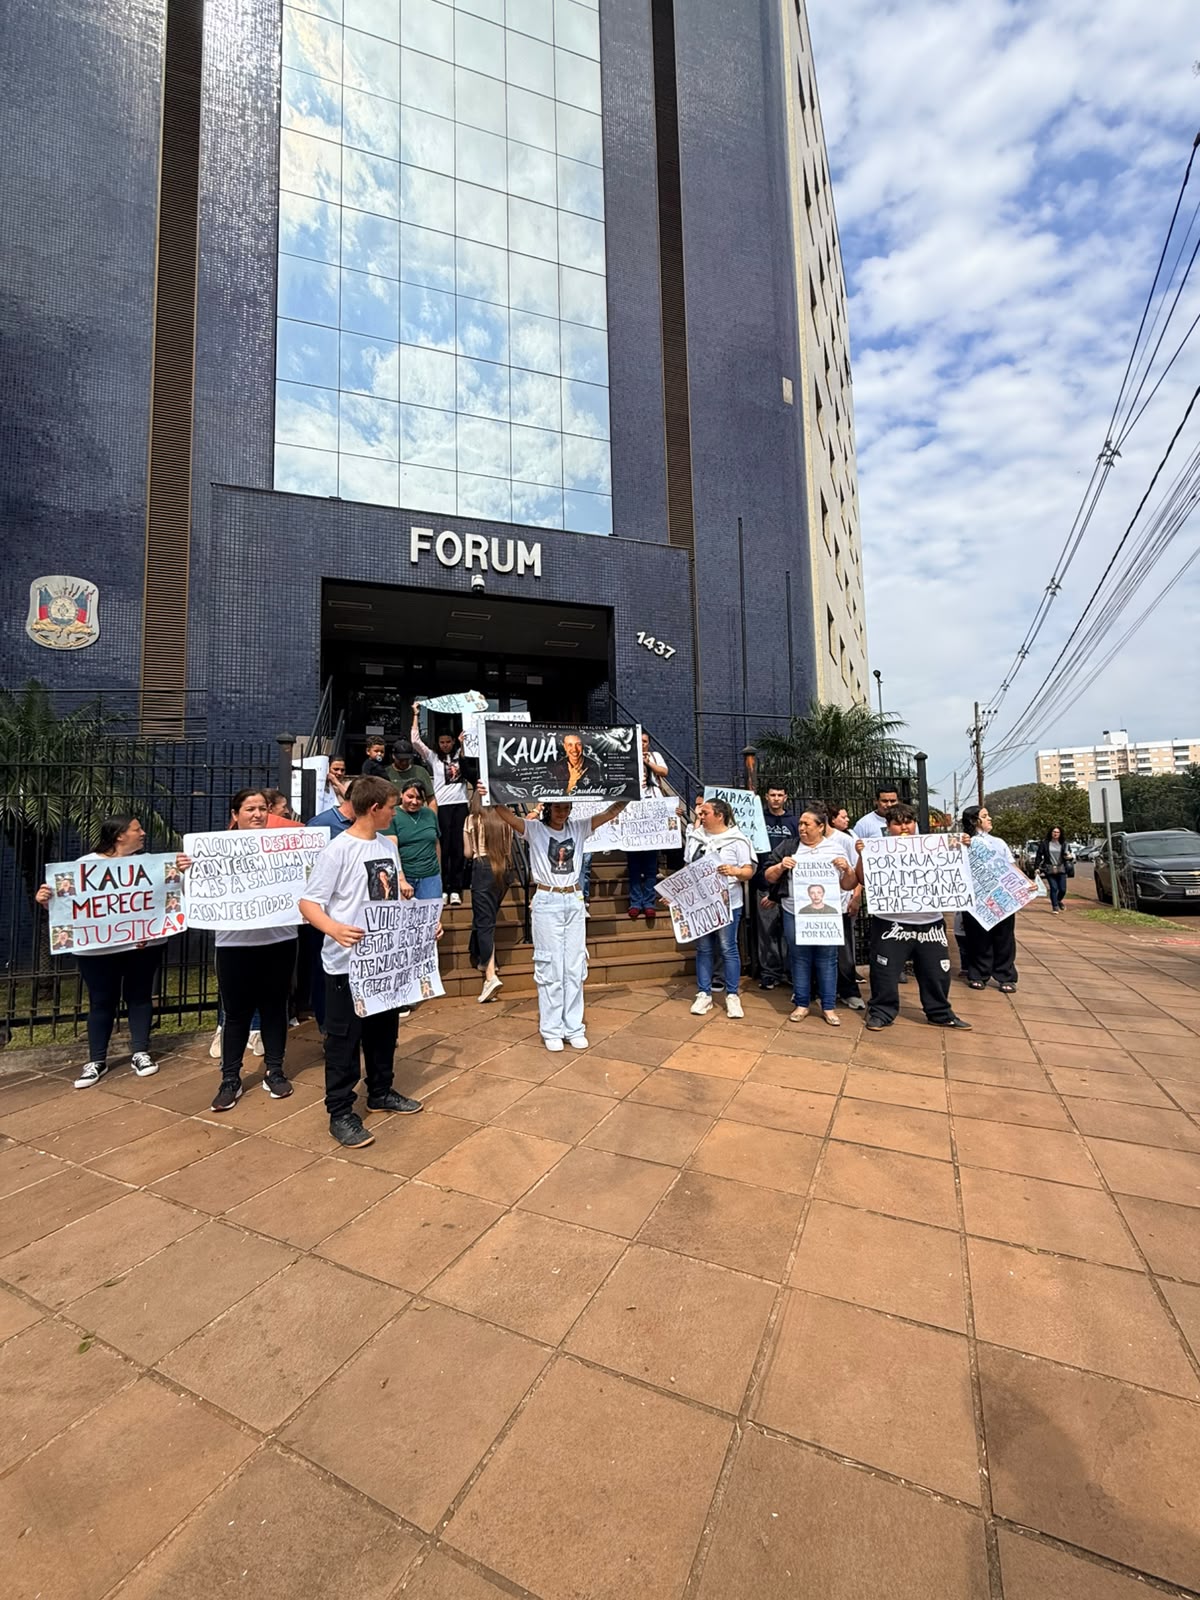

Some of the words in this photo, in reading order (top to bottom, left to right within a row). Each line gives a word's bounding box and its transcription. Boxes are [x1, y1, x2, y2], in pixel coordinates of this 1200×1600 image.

[410, 526, 542, 577] FORUM
[636, 631, 677, 660] 1437
[497, 732, 558, 767] KAUÃ
[531, 784, 564, 797] Eternas
[568, 782, 607, 796] Saudades
[867, 835, 948, 855] JUSTIÇA
[269, 850, 303, 870] UMA
[797, 861, 832, 870] ETERNAS
[867, 854, 898, 870] POR
[937, 848, 964, 867] SUA
[80, 863, 153, 892] KAUA
[190, 877, 227, 898] MAS
[231, 875, 245, 894] A
[247, 866, 304, 890] SAUDADE
[795, 870, 835, 878] SAUDADES
[865, 870, 897, 887] VIDA
[899, 867, 962, 885] IMPORTA
[868, 885, 885, 898] SUA
[72, 890, 155, 920] MERECE
[900, 894, 974, 912] ESQUECIDA
[801, 930, 818, 938] POR
[804, 921, 838, 931] JUSTIÇA
[350, 958, 375, 979] MAS
